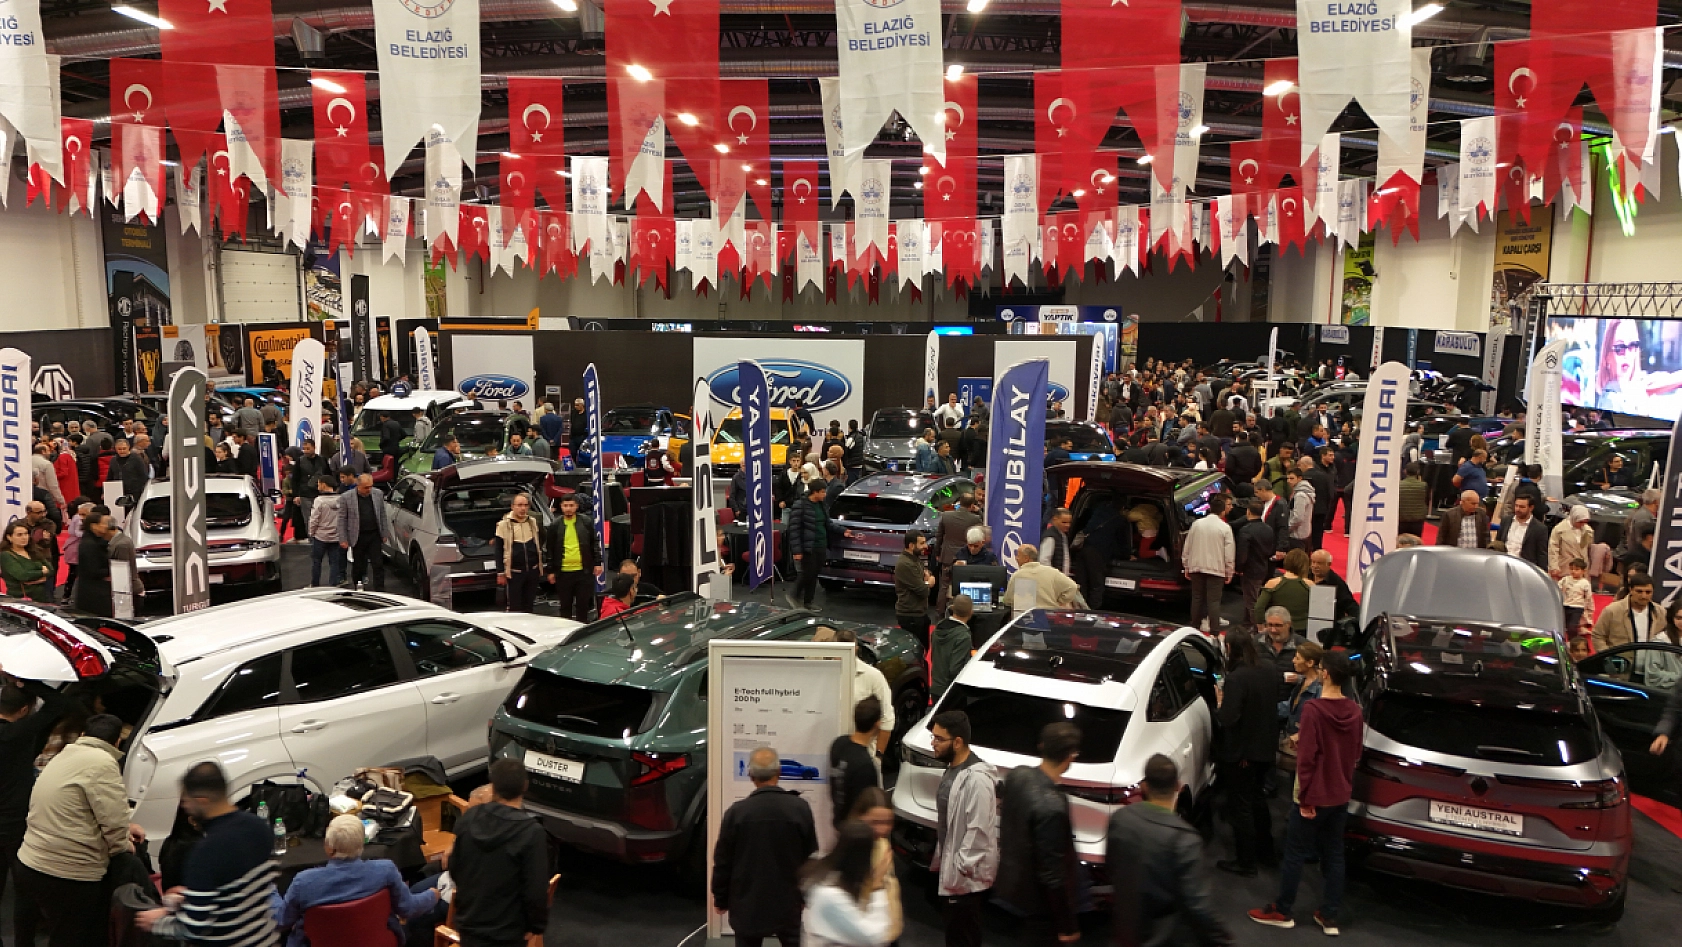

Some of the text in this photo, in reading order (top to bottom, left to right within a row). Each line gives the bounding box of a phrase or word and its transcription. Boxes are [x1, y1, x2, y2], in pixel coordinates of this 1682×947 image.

[1327, 0, 1378, 15] ELAZIĞ
[864, 14, 915, 34] ELAZIĞ
[1310, 14, 1396, 33] BELEDİYESİ
[405, 27, 453, 43] ELAZIĞ
[848, 32, 931, 51] BELEDİYESİ
[389, 43, 468, 59] BELEDİYESİ
[1435, 334, 1478, 351] KARABULUT
[298, 358, 315, 408] Ford
[472, 380, 516, 397] Ford
[1, 364, 21, 506] HYUNDAI
[1003, 385, 1030, 527] KUBİLAY
[1366, 379, 1398, 522] HYUNDAI
[750, 695, 761, 704] hp
[774, 688, 801, 697] hybrid
[537, 757, 569, 772] DUSTER
[1437, 804, 1517, 824] YENİ AUSTRAL
